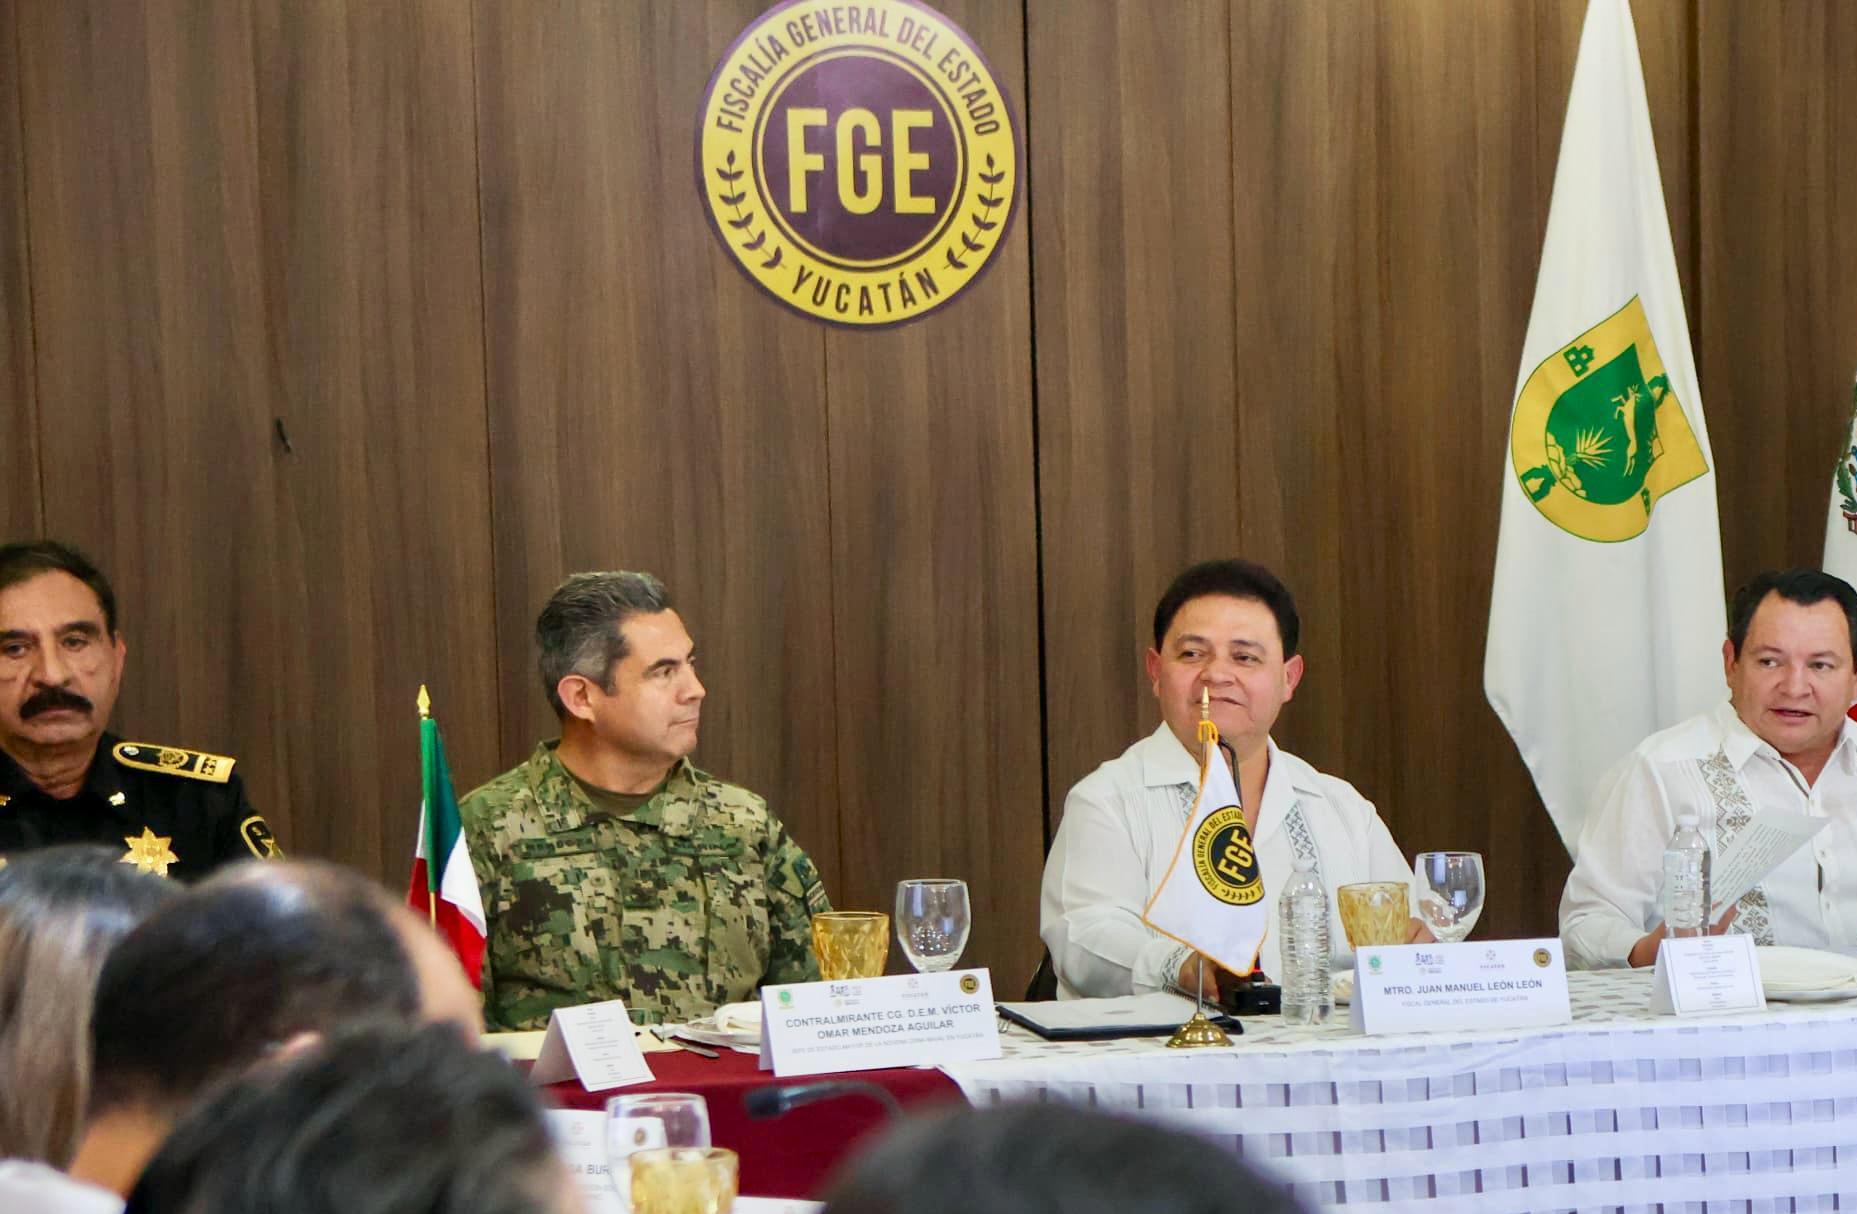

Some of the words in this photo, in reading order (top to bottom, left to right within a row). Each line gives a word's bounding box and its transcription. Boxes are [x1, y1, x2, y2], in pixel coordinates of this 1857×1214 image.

[716, 31, 790, 133] FISCALÍA
[785, 5, 890, 48] GENERAL
[896, 16, 939, 60] DEL
[938, 47, 999, 136] ESTADO
[786, 107, 937, 215] FGE
[791, 264, 940, 317] YUCATÁN
[1384, 986, 1413, 996] MTRO.
[1417, 984, 1442, 994] JUAN
[1445, 982, 1485, 993] MANUEL
[1487, 979, 1514, 991] LEÓN
[1516, 976, 1543, 989] LEÓN
[785, 1011, 884, 1028] CONTRALMIRANTE
[907, 1007, 939, 1018] D.E.M.
[941, 1003, 981, 1015] VÍCTOR
[817, 1028, 849, 1039] OMAR
[851, 1023, 905, 1036] MENDOZA
[907, 1019, 954, 1031] AGUILAR
